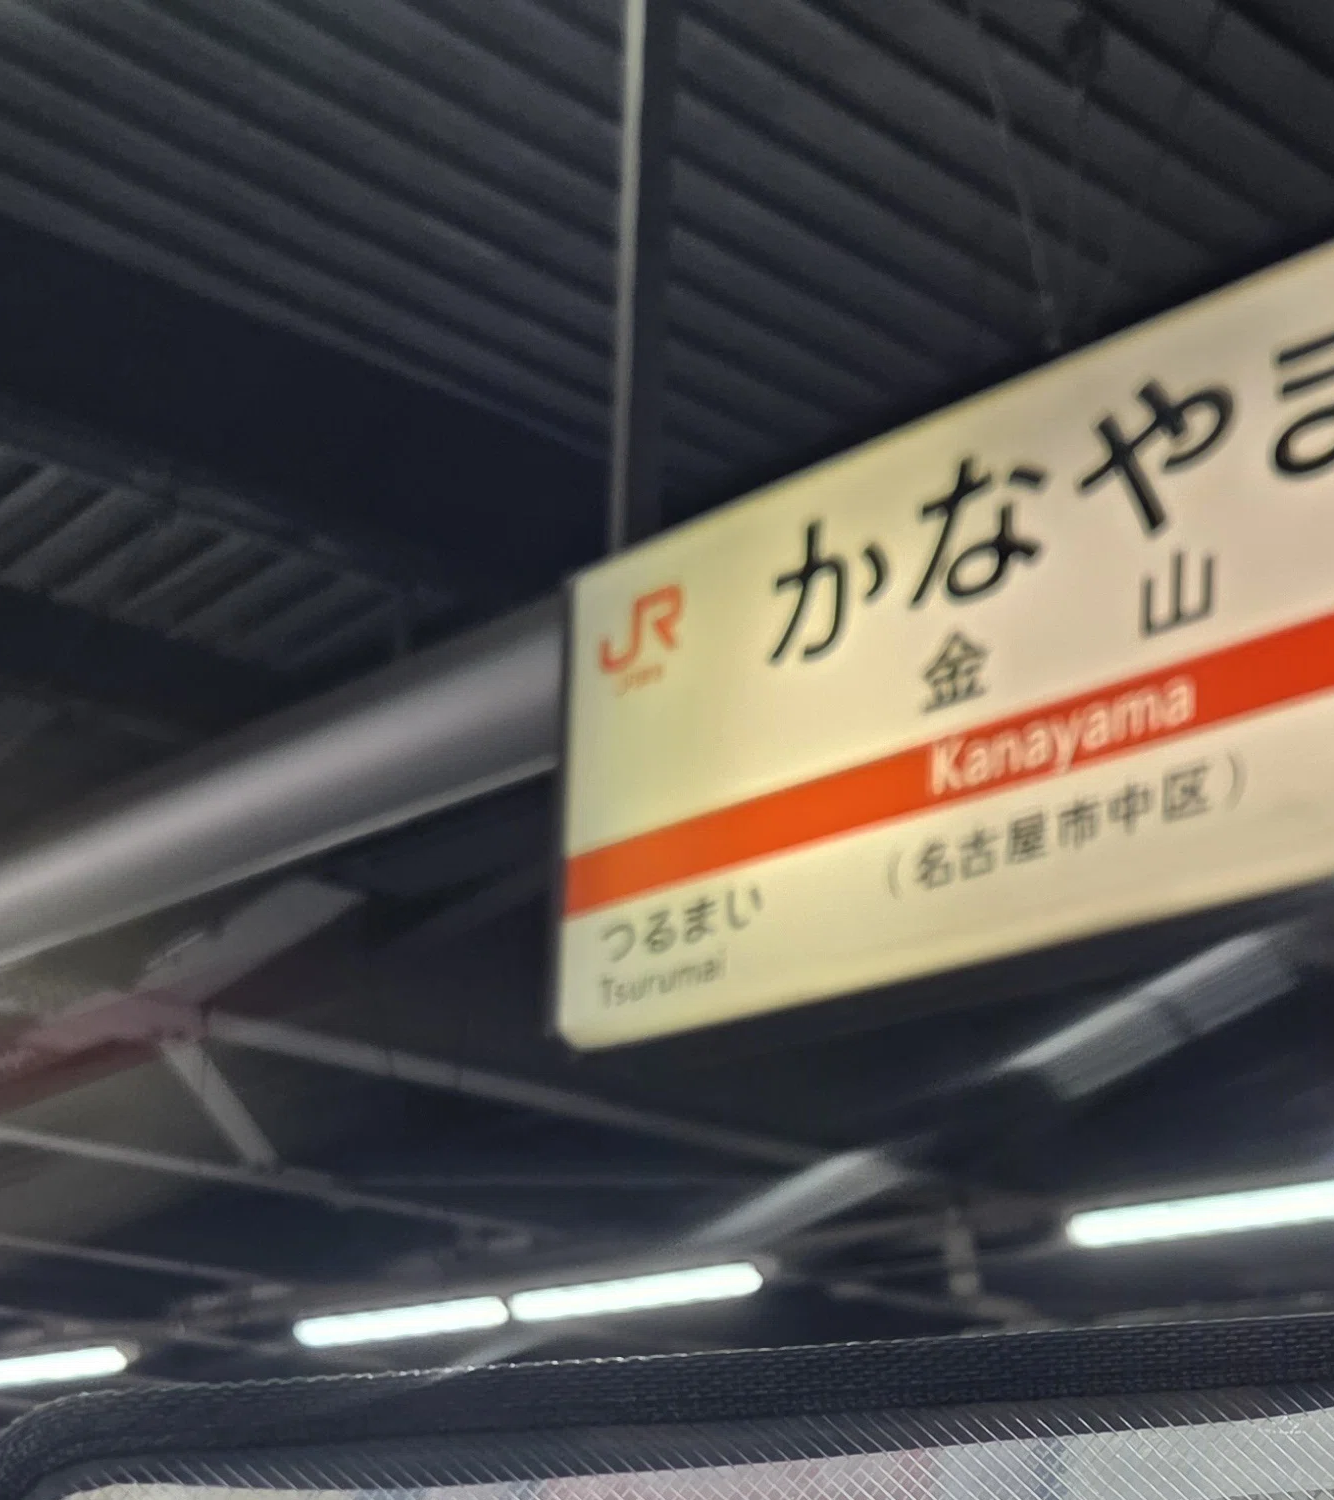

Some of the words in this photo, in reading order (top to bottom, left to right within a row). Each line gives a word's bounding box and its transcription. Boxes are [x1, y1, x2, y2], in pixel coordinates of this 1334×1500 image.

[598, 582, 685, 675] JR
[919, 547, 1216, 713] 金山
[926, 672, 1197, 796] Kanayama
[598, 879, 765, 964] つるまい
[597, 946, 727, 1011] Tsurumai
